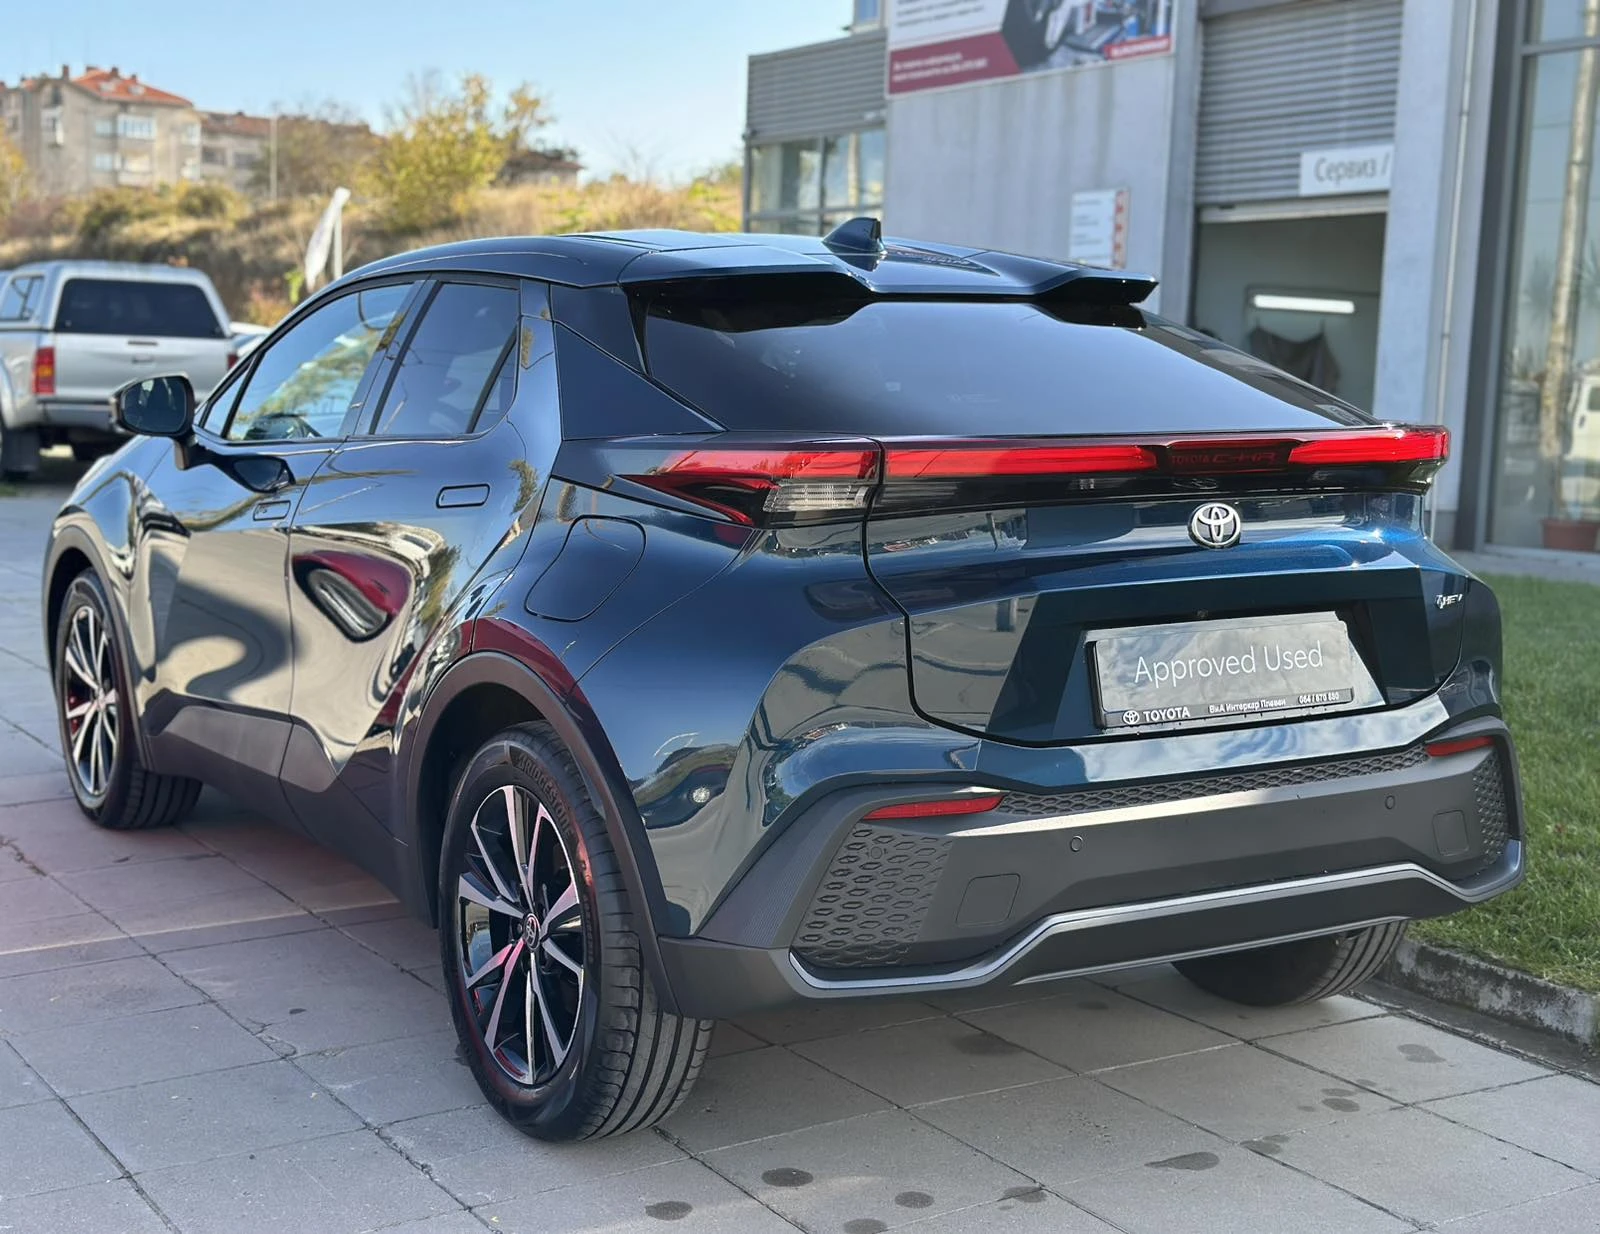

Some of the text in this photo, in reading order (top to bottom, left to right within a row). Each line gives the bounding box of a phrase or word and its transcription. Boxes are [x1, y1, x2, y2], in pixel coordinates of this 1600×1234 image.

[1313, 156, 1377, 186] Сервиз
[1134, 640, 1323, 688] Approved Used
[1143, 706, 1191, 723] TOYOTA
